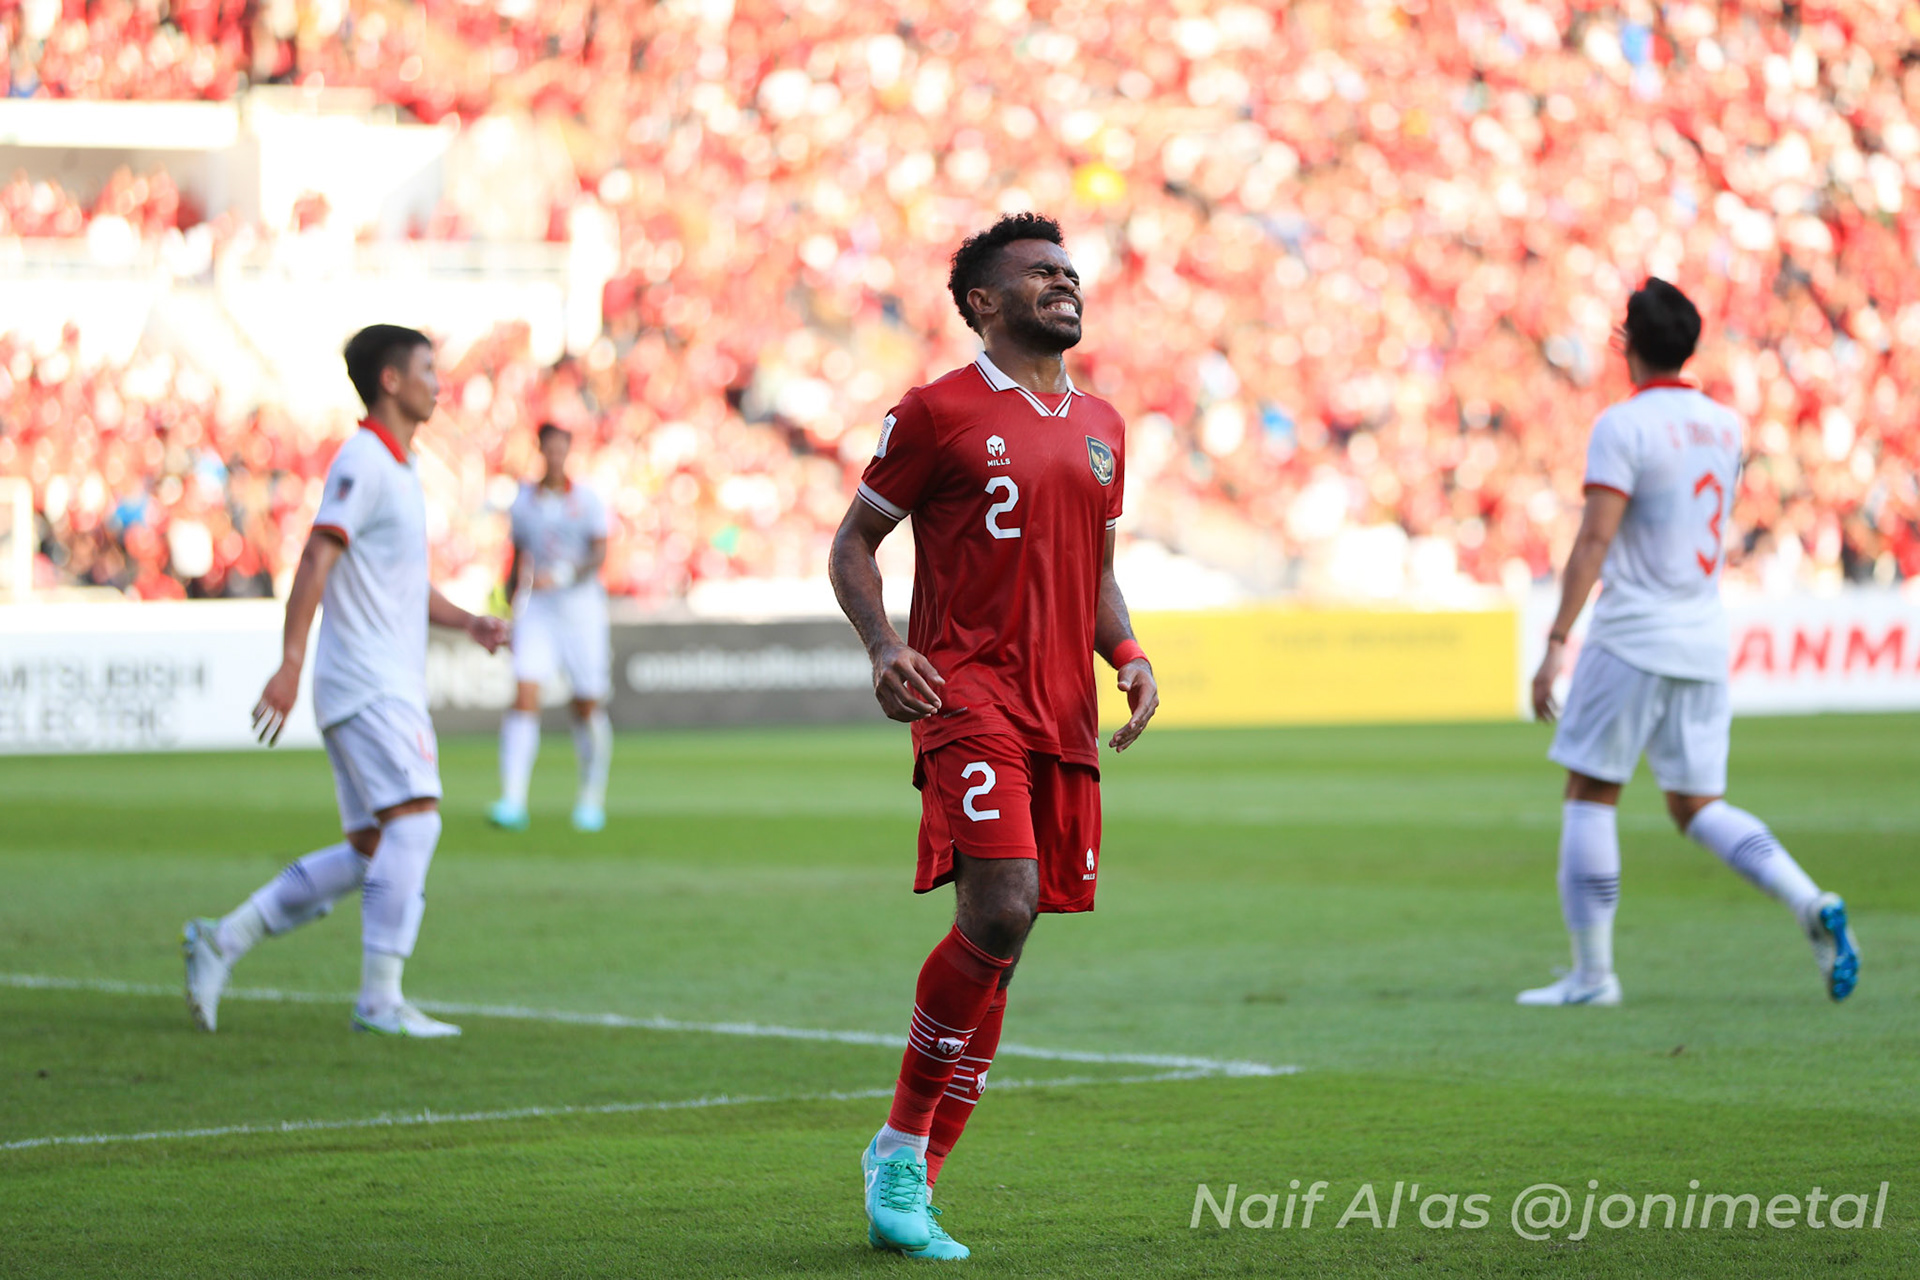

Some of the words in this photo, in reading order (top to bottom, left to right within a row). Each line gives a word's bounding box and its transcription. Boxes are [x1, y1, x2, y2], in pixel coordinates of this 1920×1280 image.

[987, 458, 1011, 467] MILLS
[984, 475, 1021, 539] 2
[1693, 470, 1723, 577] 3
[961, 761, 1000, 822] 2
